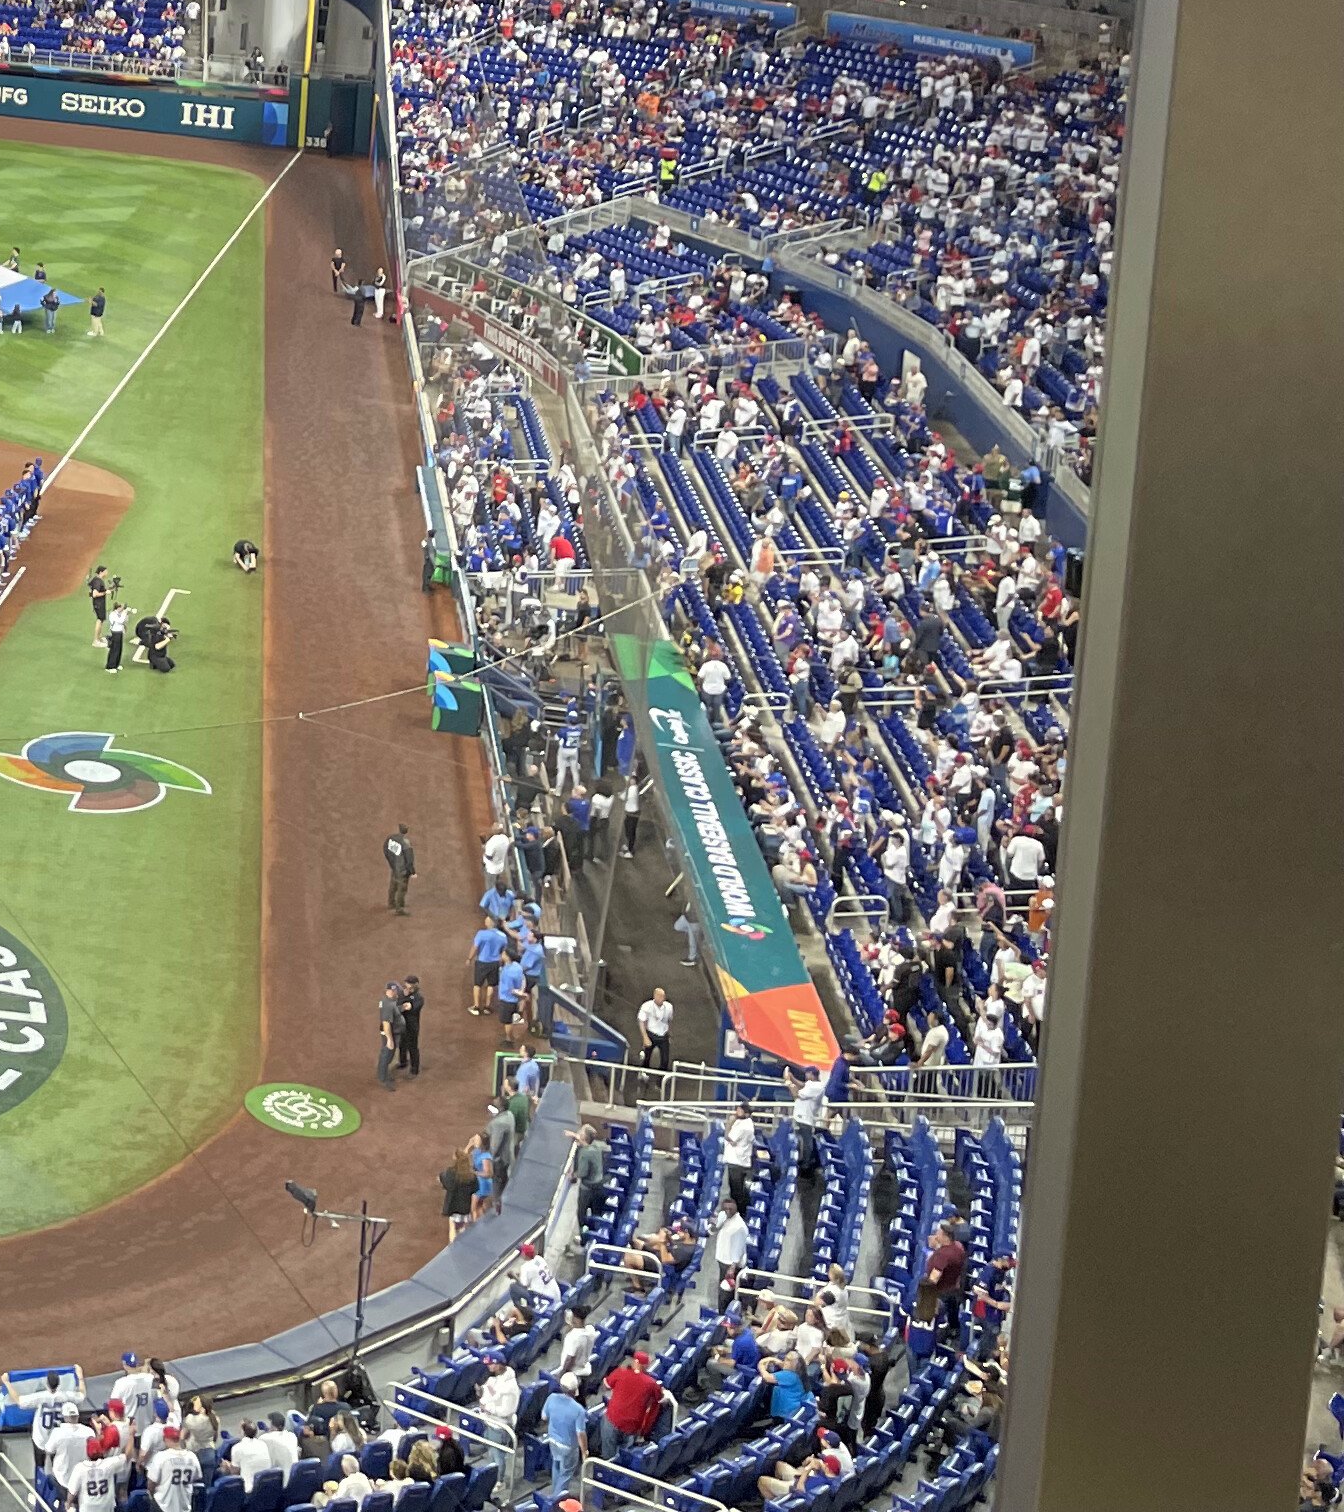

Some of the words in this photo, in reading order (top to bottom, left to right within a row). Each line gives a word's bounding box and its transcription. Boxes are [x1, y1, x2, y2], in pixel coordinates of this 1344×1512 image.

[61, 92, 145, 118] SEIKO
[180, 102, 235, 130] IHI
[671, 752, 712, 802] CLASSIC
[689, 801, 738, 866] BASEBALL
[712, 865, 756, 918] WORLD
[786, 1009, 834, 1065] MIAMI
[86, 1478, 109, 1497] 22
[171, 1468, 192, 1486] 23
